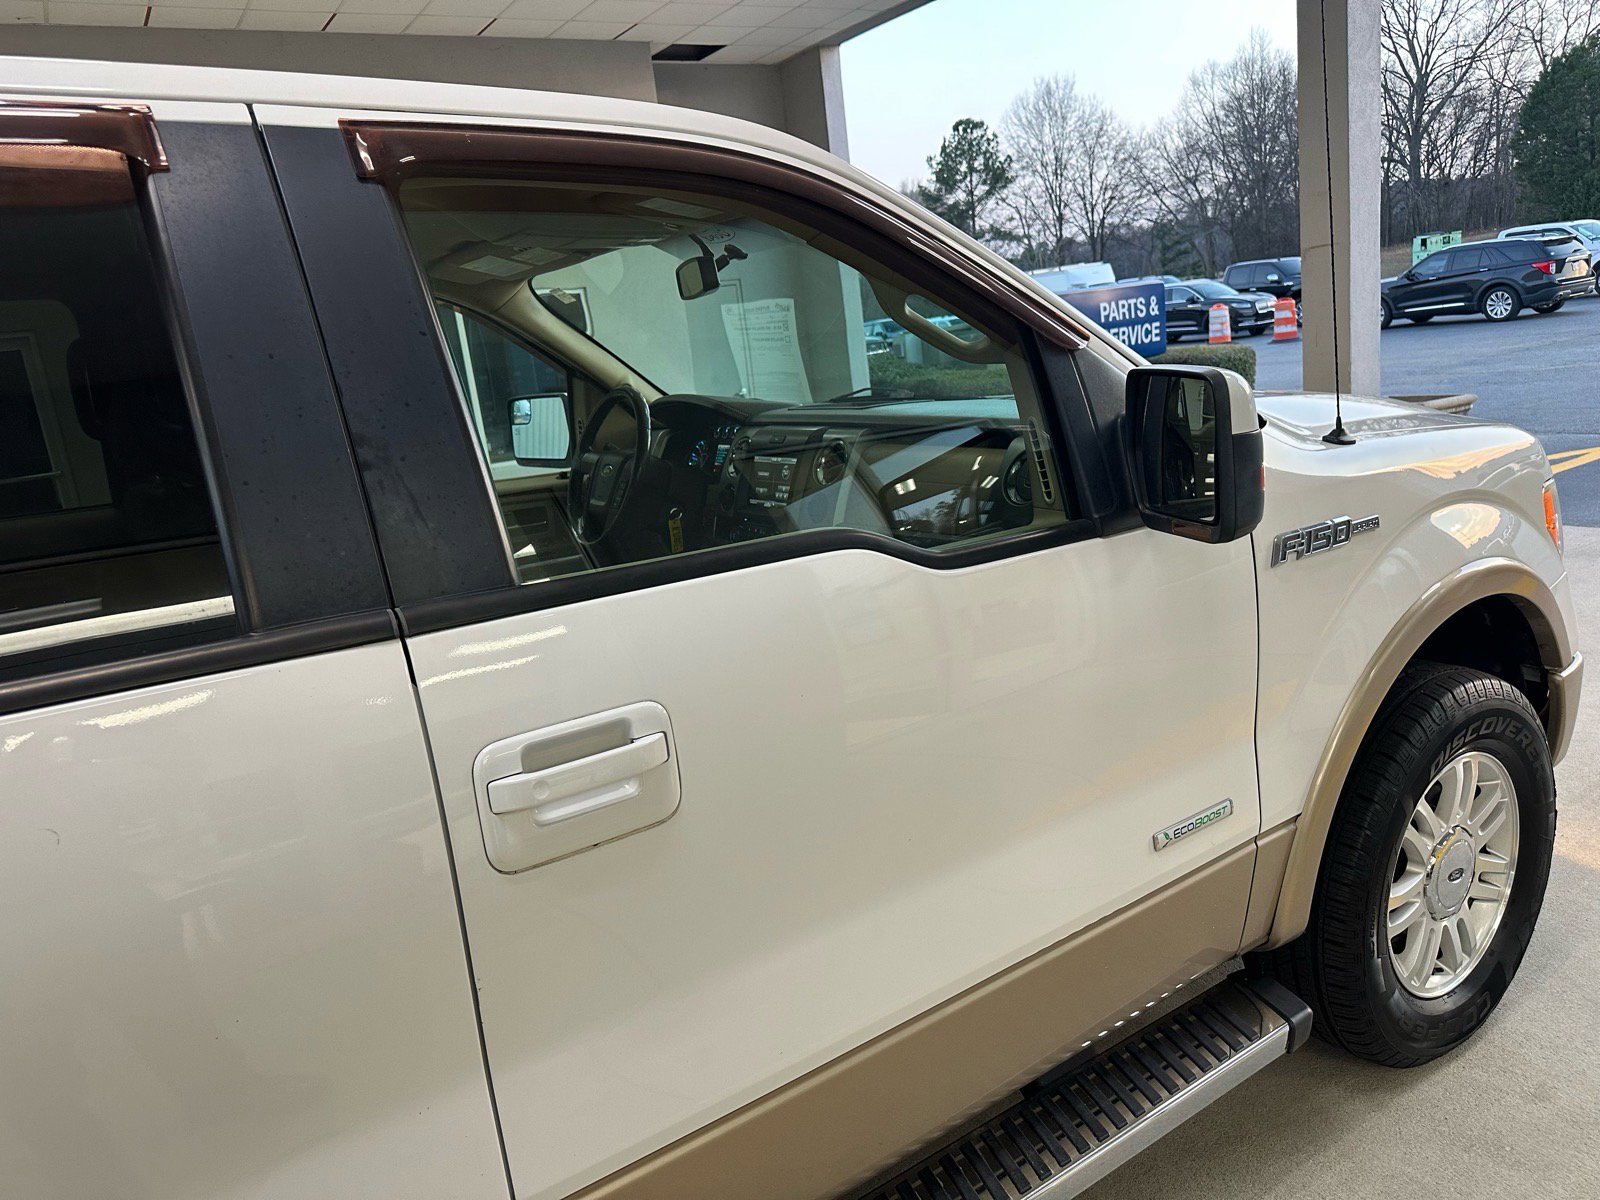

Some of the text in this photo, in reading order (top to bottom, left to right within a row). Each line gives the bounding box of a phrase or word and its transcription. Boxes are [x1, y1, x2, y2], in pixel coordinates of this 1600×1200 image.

[1100, 295, 1159, 323] PARTS &
[1109, 322, 1161, 346] ERVICE
